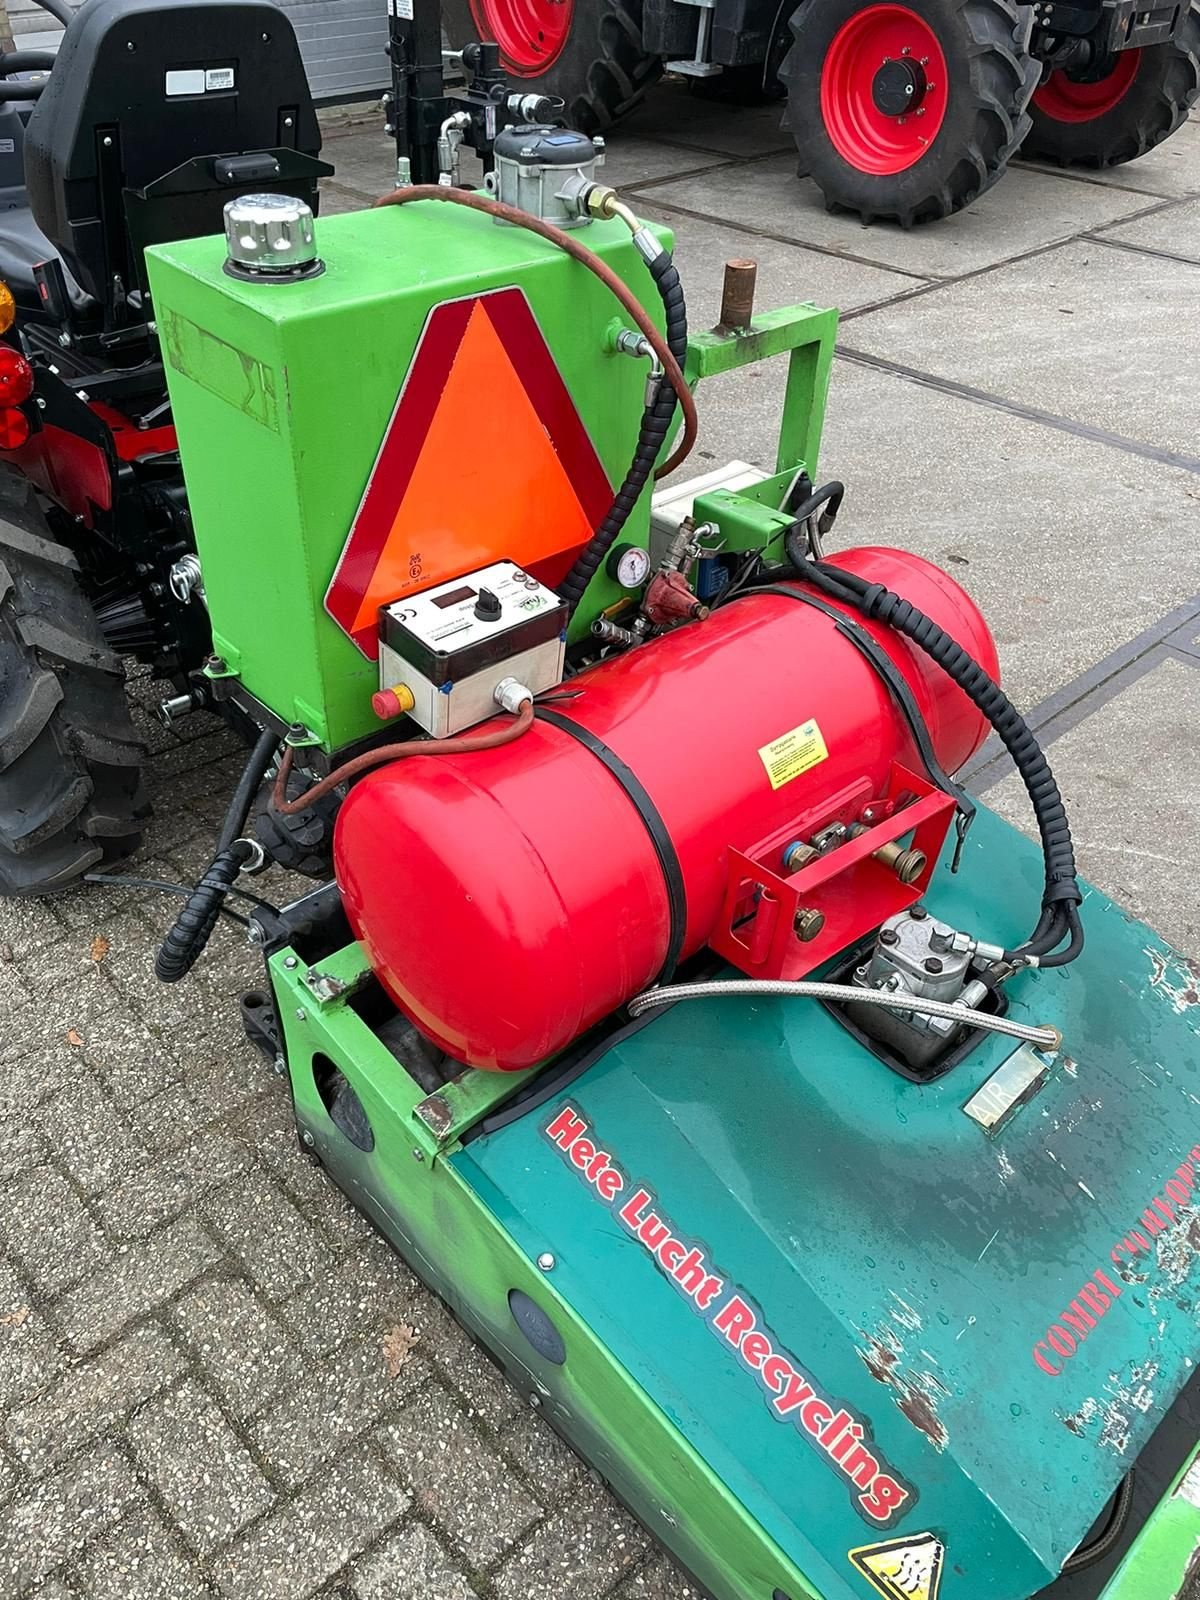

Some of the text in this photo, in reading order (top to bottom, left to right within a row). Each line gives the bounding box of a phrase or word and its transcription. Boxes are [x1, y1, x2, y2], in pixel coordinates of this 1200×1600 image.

[969, 1081, 1017, 1121] AIR
[545, 1106, 909, 1521] Hete Lucht Recycling
[1033, 1268, 1124, 1377] COMBI
